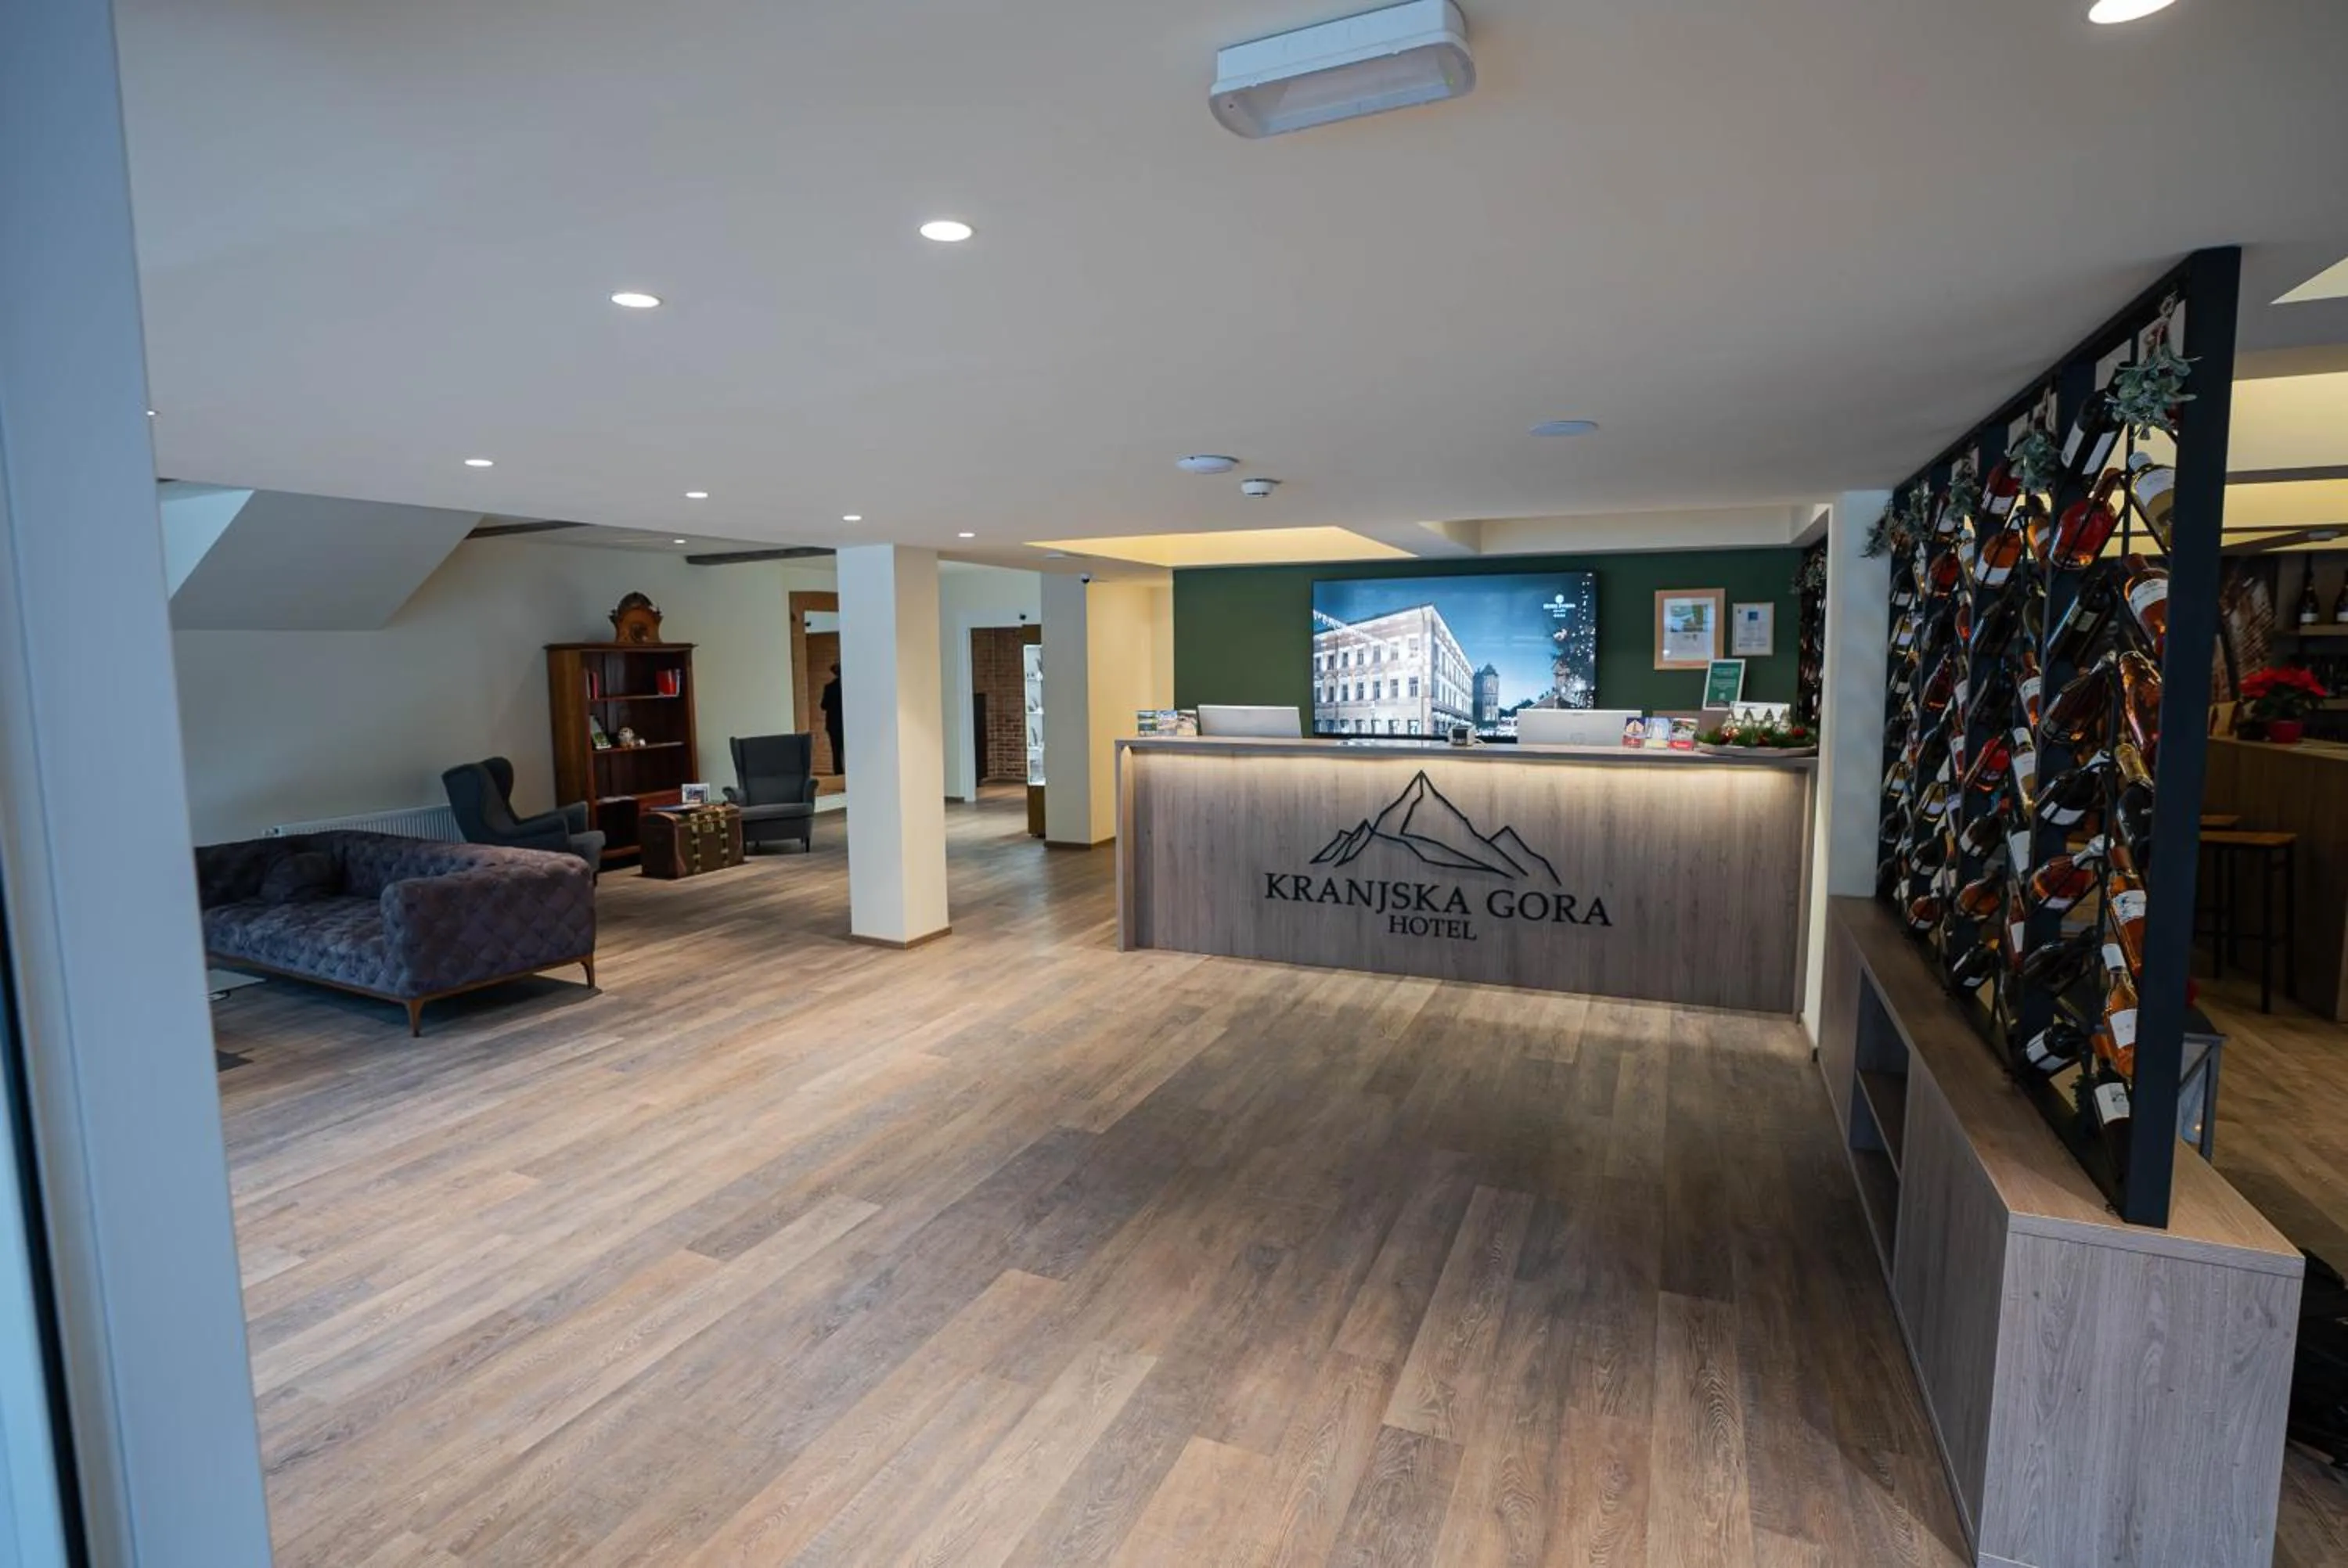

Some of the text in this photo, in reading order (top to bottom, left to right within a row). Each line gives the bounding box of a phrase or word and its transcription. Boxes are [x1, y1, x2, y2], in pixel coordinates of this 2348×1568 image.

[1264, 872, 1612, 926] KRANJSKA GORA
[1388, 914, 1478, 940] HOTEL
